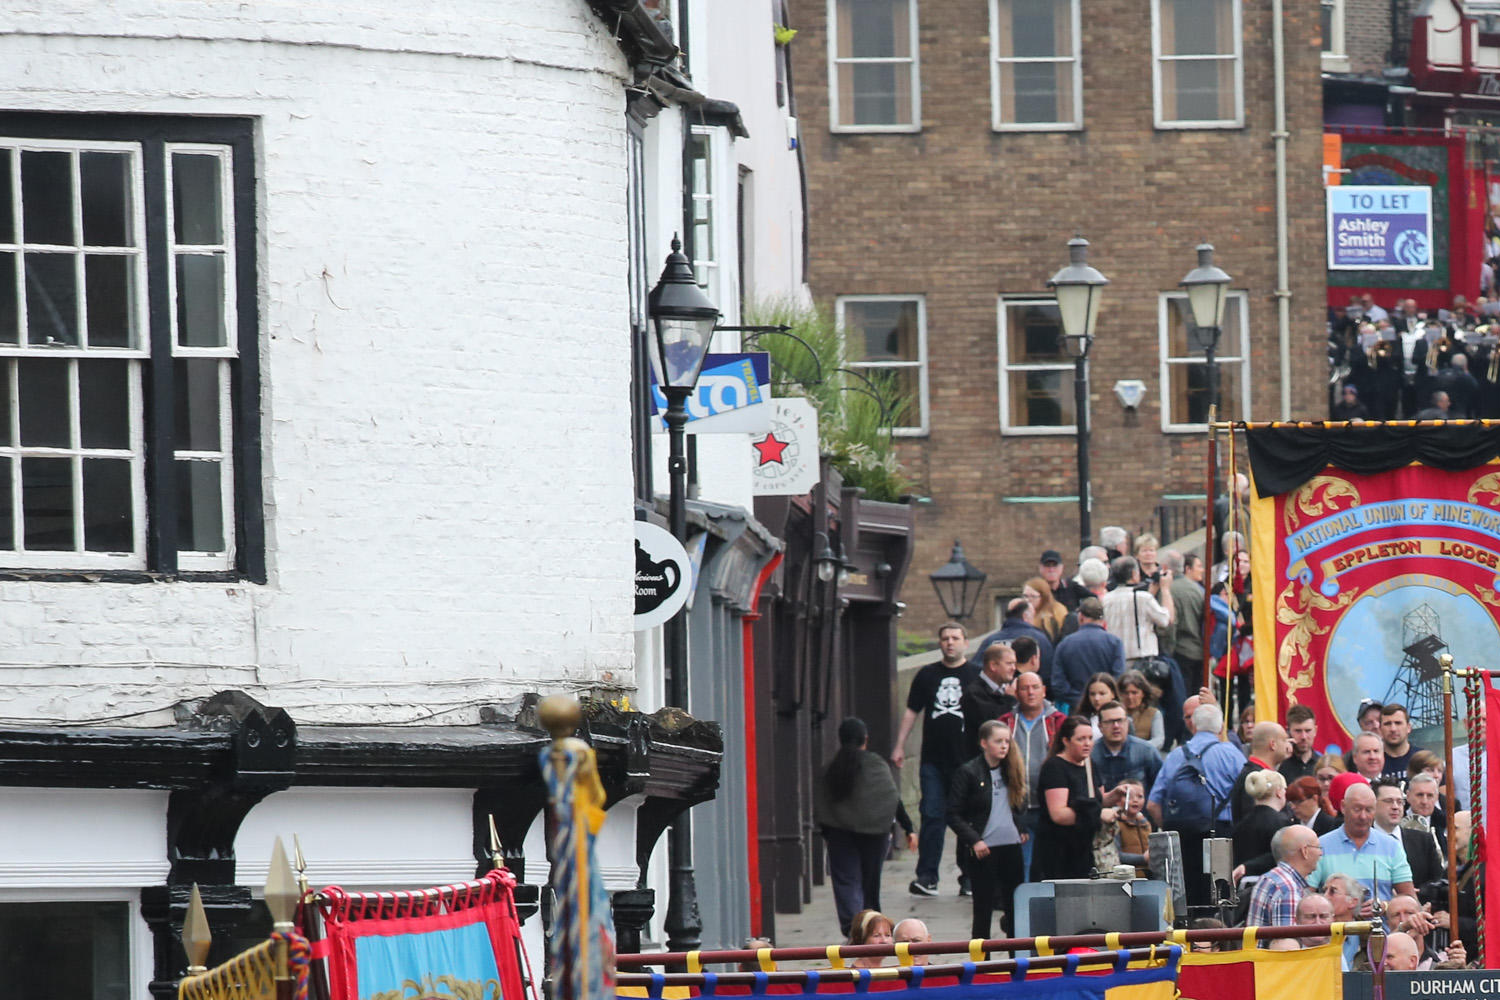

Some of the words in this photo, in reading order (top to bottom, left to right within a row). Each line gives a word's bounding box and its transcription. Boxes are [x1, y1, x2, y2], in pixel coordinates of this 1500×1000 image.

[1350, 194, 1373, 209] TO
[1381, 194, 1409, 209] LET
[1337, 218, 1389, 234] Ashley
[1337, 232, 1385, 247] Smith
[1293, 517, 1363, 552] NATIONAL
[1364, 503, 1406, 525] UNION
[1409, 503, 1427, 521] OF
[1332, 540, 1422, 573] EPPLETON
[1440, 541, 1500, 568] LODGE
[1410, 979, 1475, 995] DURHAM
